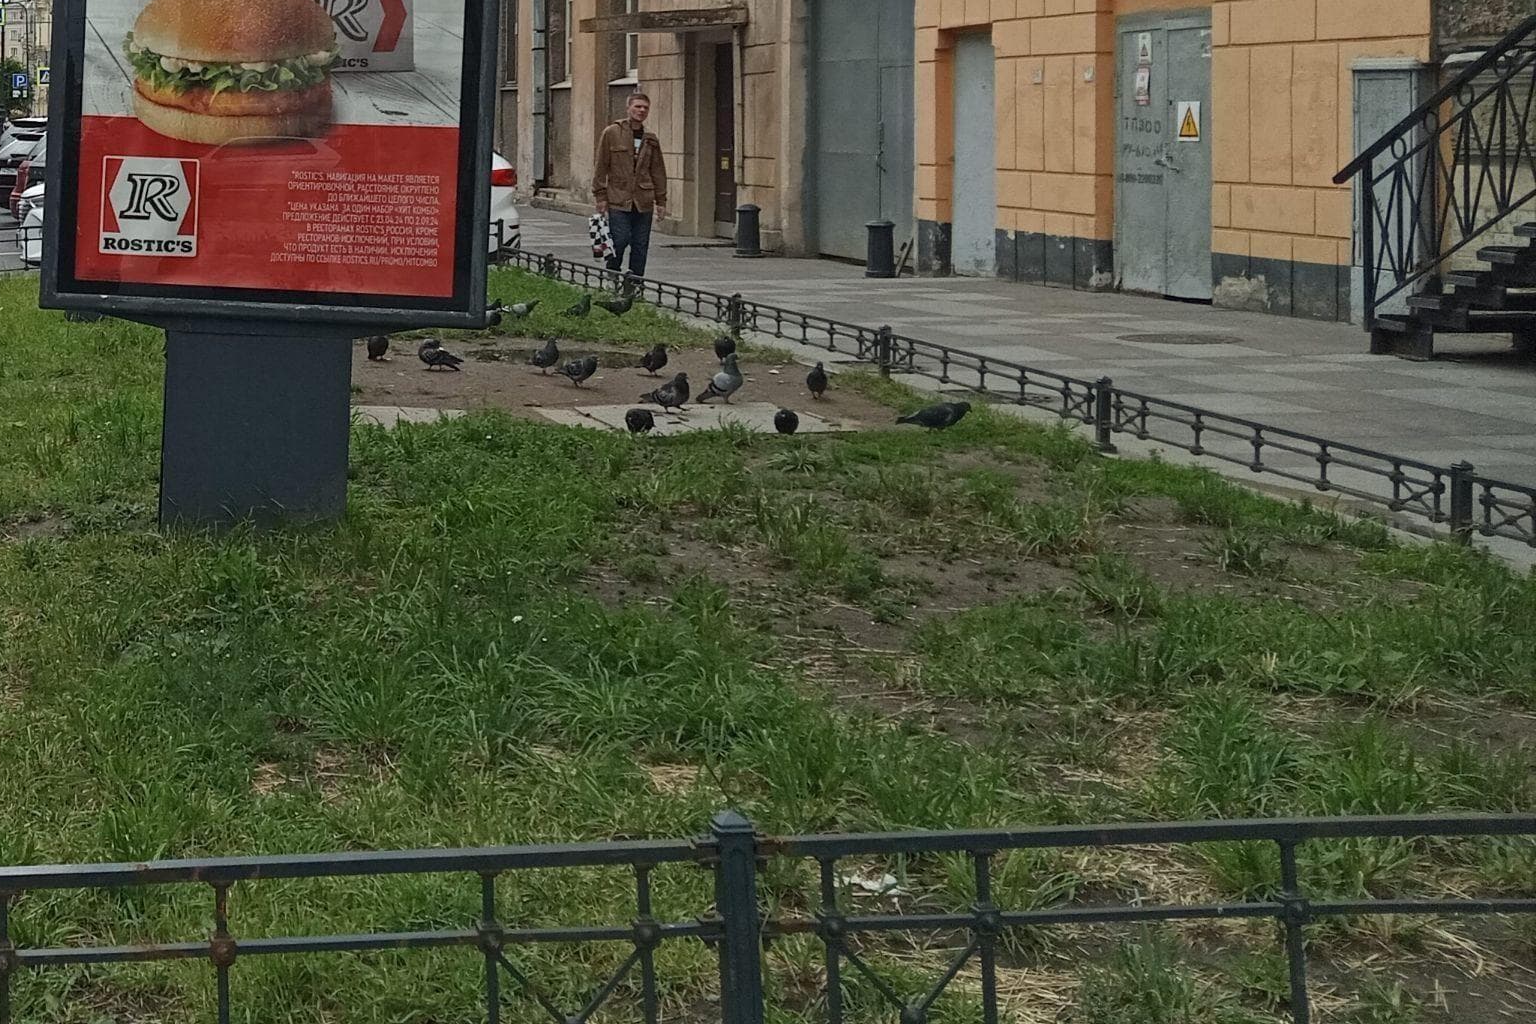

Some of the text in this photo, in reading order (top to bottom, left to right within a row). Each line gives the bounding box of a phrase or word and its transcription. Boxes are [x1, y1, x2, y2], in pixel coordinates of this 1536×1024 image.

[342, 58, 369, 68] IC'S
[366, 173, 376, 182] НА
[377, 174, 403, 183] МАКЕТЕ
[118, 173, 180, 222] R
[327, 193, 337, 202] ДО
[387, 195, 414, 204] ЦЕЛОГО
[308, 202, 339, 212] УКАЗАНА
[341, 203, 350, 212] ЗА
[351, 204, 370, 213] ОДИН
[371, 204, 393, 214] НАБОР
[404, 215, 414, 224] ПО
[306, 223, 311, 232] В
[312, 223, 354, 233] РЕСТОРАНАХ
[415, 227, 439, 236] КРОМЕ
[103, 237, 193, 252] ROSTIC'S
[283, 243, 297, 252] ЧТО
[297, 243, 329, 253] ПРОДУКТ
[330, 244, 347, 253] ЕСТЬ
[347, 245, 352, 254] В
[305, 253, 315, 263] ПО
